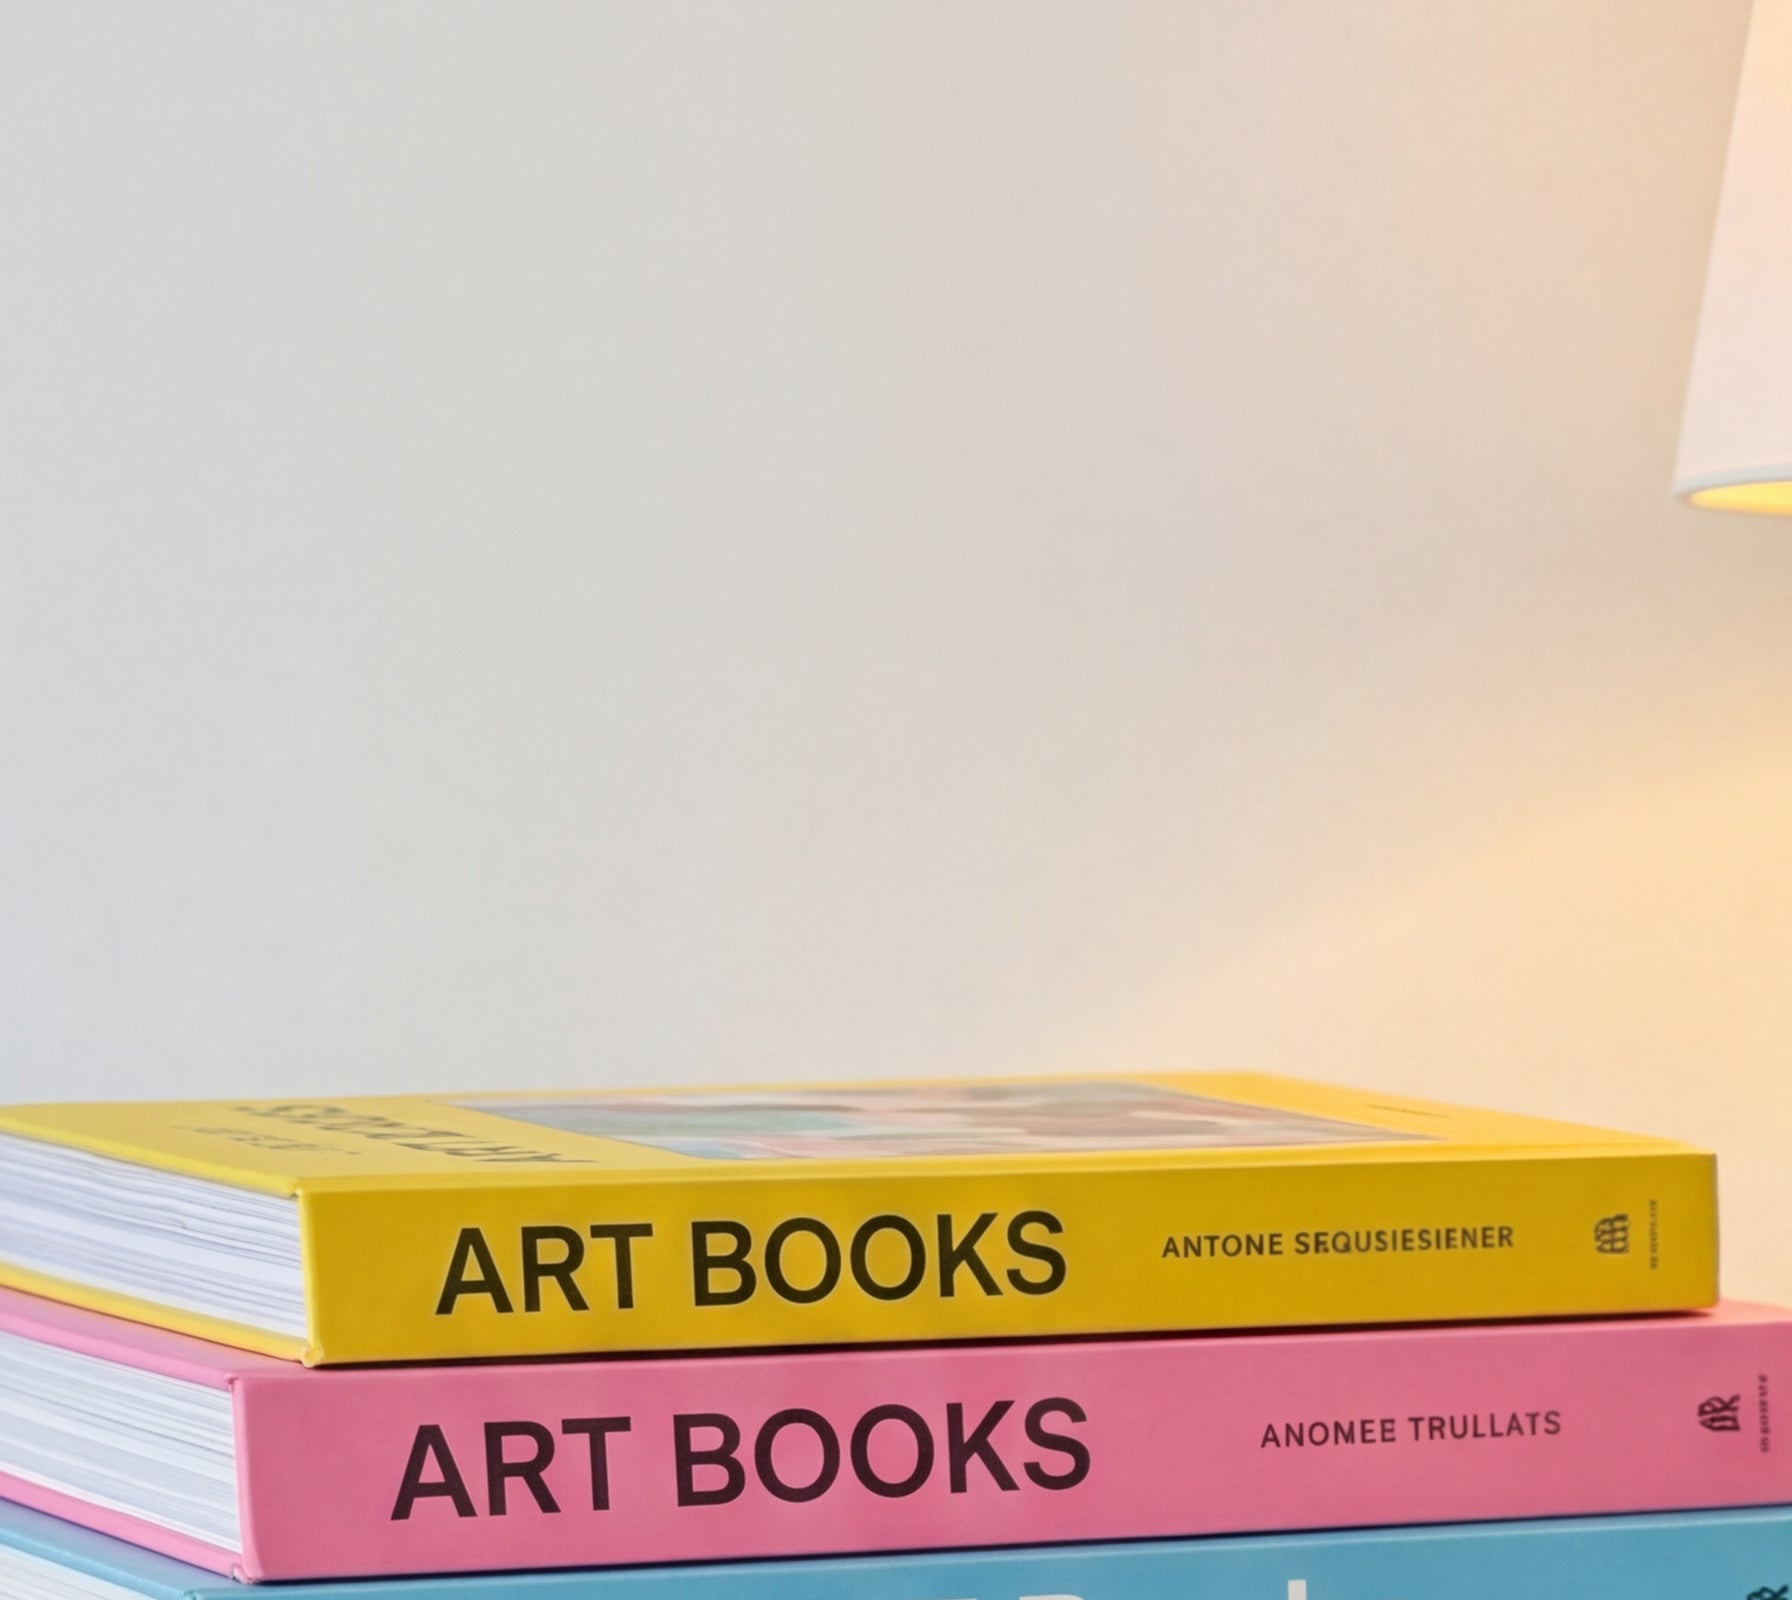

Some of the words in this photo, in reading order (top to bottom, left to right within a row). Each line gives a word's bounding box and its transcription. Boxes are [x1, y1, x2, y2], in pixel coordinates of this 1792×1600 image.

[435, 1222, 653, 1316] ART
[691, 1209, 1067, 1308] BOOKS
[1161, 1232, 1284, 1259] ANTONE
[390, 1415, 631, 1521] ART
[672, 1396, 1091, 1508] BOOKS
[1408, 1410, 1562, 1442] TRULLATS
